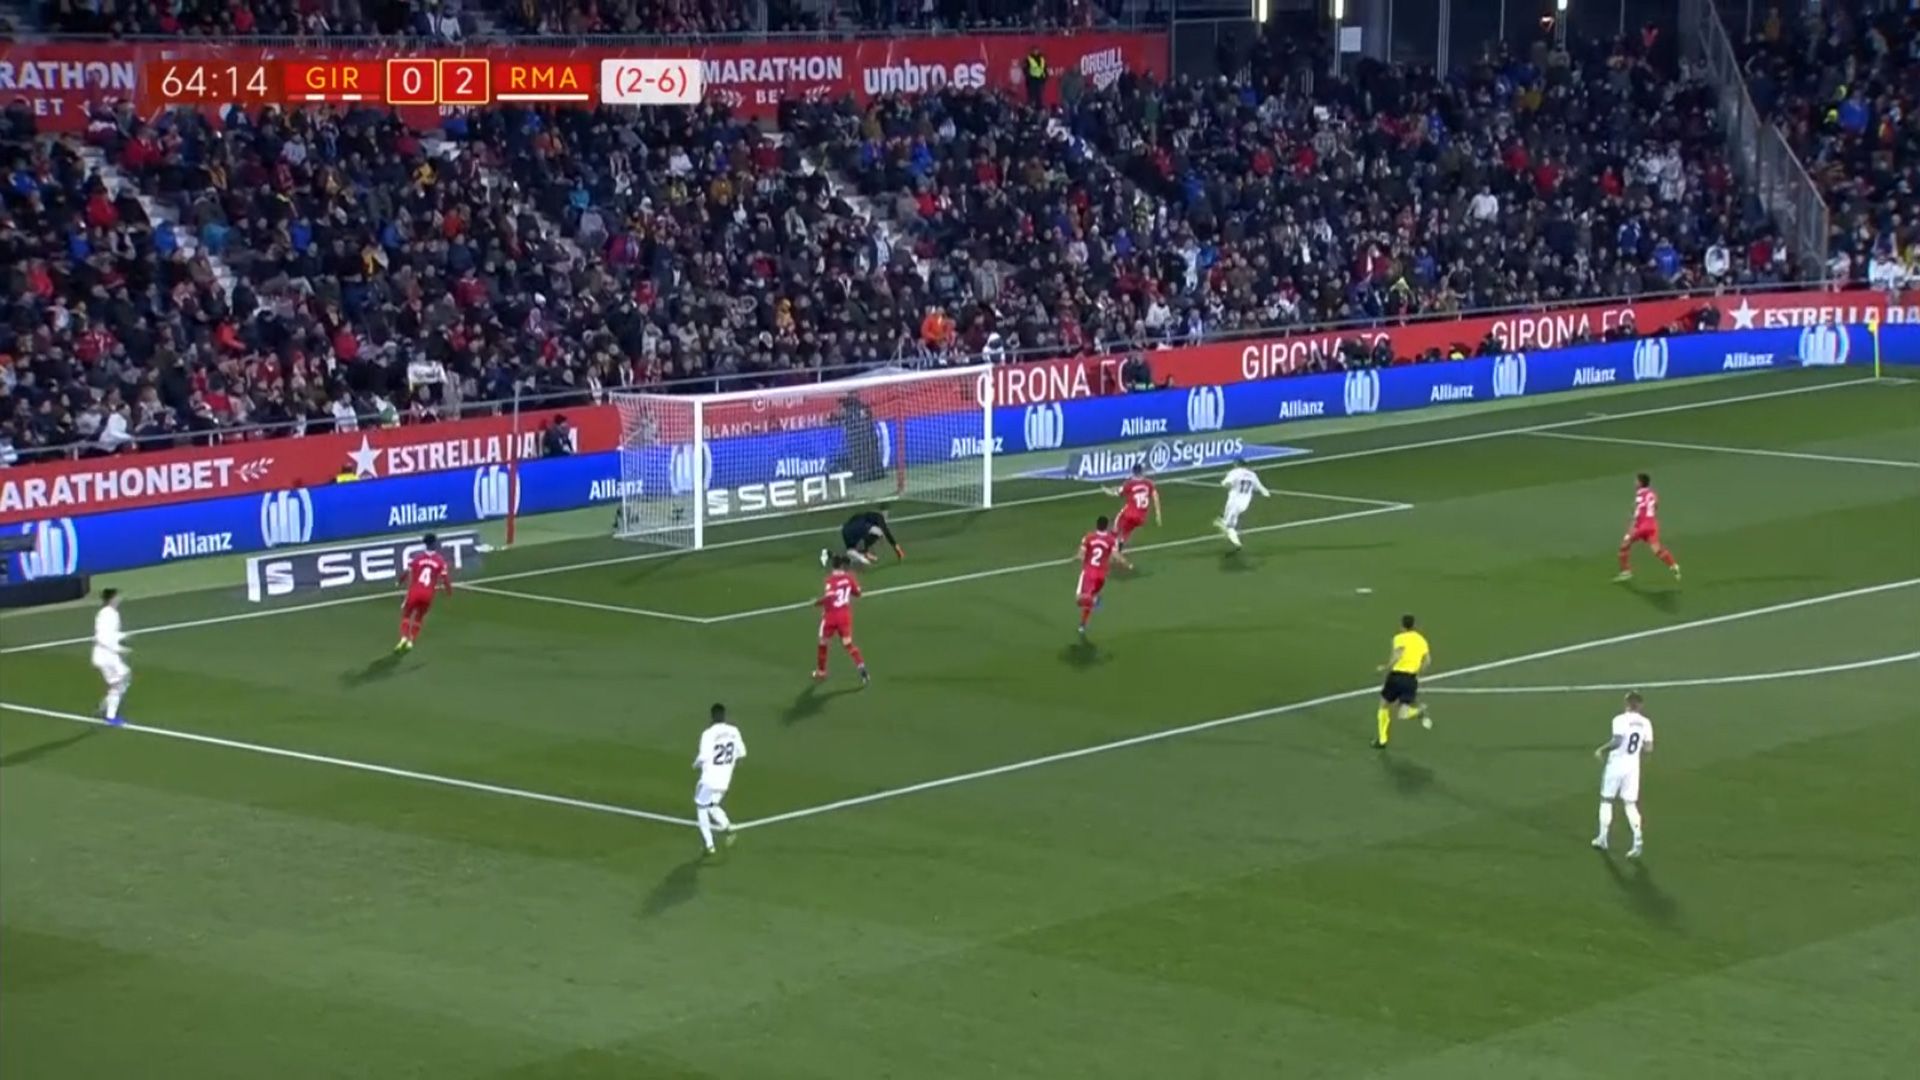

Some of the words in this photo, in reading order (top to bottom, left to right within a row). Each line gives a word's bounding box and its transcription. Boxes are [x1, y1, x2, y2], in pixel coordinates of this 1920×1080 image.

[701, 56, 843, 84] MARATHON
[863, 57, 987, 95] umbro.es
[1764, 306, 1881, 328] ESTRELLA
[1242, 336, 1346, 380] GIRON
[1723, 351, 1774, 371] Allianz
[1573, 366, 1616, 386] Allianz
[1430, 383, 1474, 402] Allianz
[1279, 400, 1325, 420] Allianz
[1121, 416, 1168, 437] Allianz
[387, 434, 501, 476] ESTRELLA
[1077, 449, 1147, 477] Allianz
[1172, 437, 1244, 466] Seguros
[775, 457, 827, 479] Allianz
[0, 458, 235, 512] ARATHONBET
[588, 479, 644, 501] Allianz
[738, 472, 854, 511] SEAT
[387, 503, 449, 527] Allianz
[162, 531, 233, 559] Allianz
[1090, 546, 1103, 567] 2
[418, 566, 432, 587] 4
[712, 741, 735, 766] 28
[1627, 732, 1640, 755] 8
